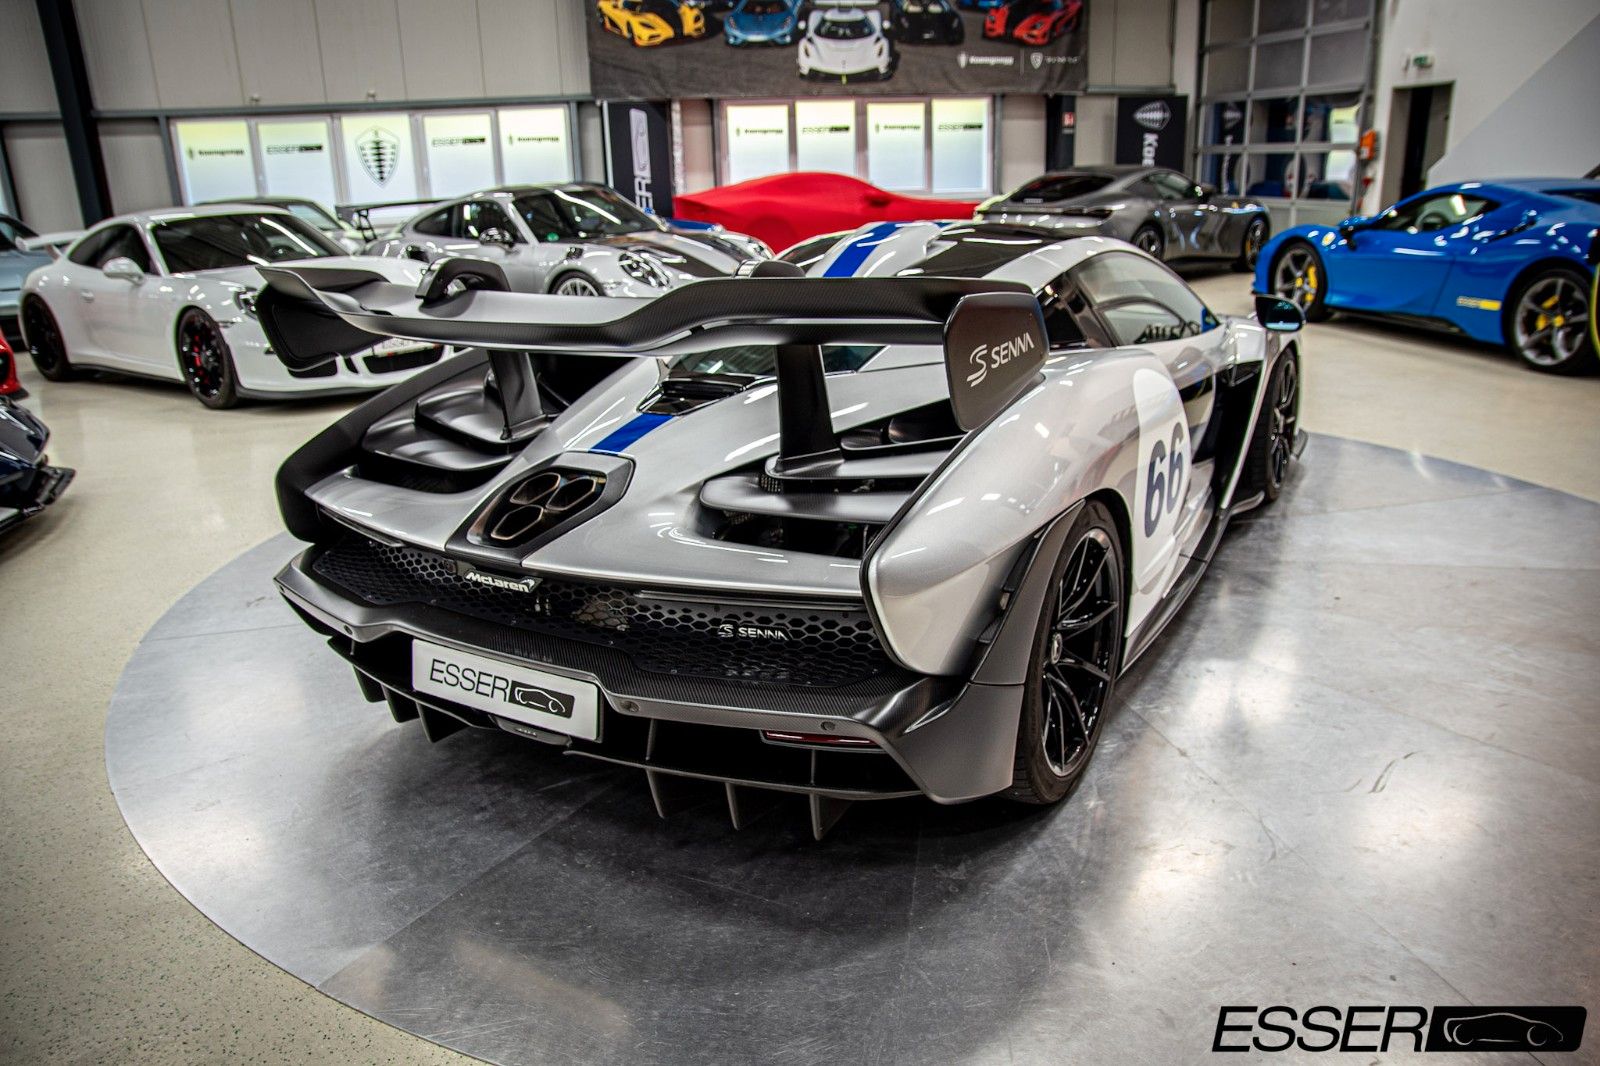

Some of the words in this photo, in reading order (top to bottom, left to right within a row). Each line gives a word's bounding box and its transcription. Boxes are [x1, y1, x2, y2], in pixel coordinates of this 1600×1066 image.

[991, 332, 1035, 369] SENNA
[1144, 422, 1184, 538] 66
[465, 571, 530, 593] McLaren
[738, 627, 789, 641] SENNA
[430, 658, 509, 703] ESSER
